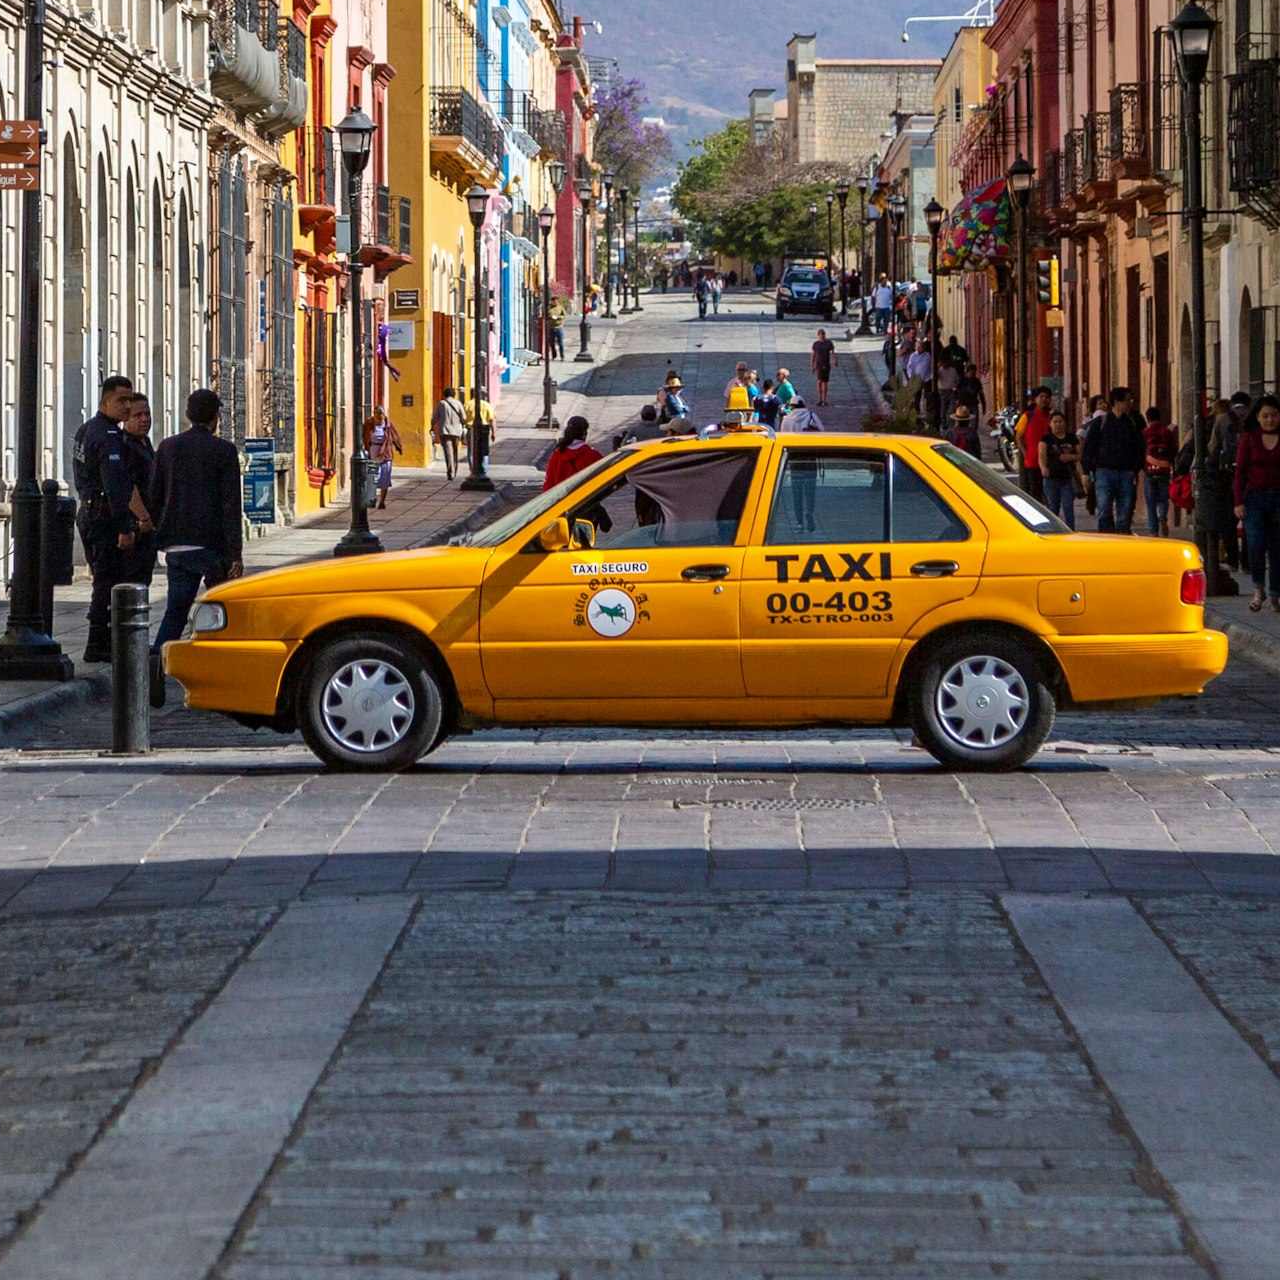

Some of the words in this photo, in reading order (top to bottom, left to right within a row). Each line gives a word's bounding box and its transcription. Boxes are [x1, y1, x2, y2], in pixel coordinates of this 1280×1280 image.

[572, 564, 598, 574] TAXI
[601, 562, 648, 573] SEGURO
[765, 552, 892, 583] TAXI
[588, 576, 637, 593] Oaxaca
[766, 591, 893, 614] 00-403
[766, 613, 894, 624] TX-CTRO-003
